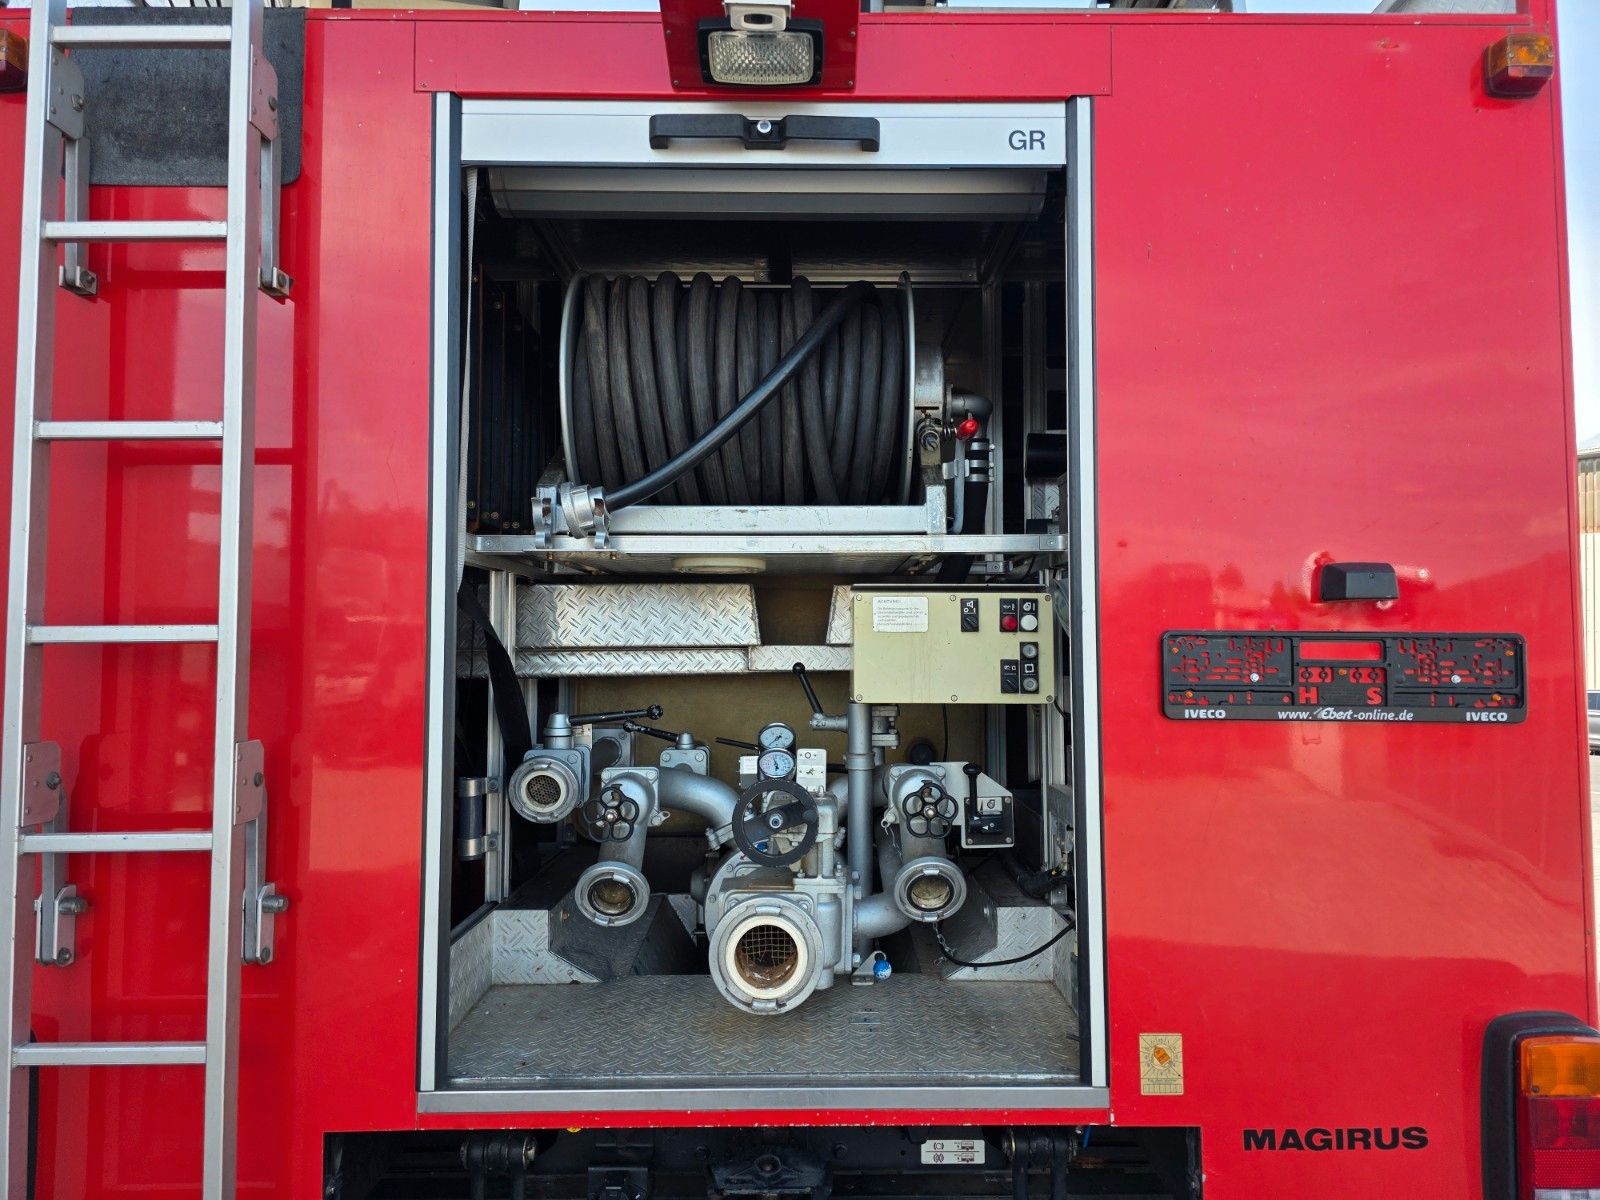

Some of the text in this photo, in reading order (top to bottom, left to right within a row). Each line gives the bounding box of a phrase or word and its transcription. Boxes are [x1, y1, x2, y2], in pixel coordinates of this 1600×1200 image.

[1008, 130, 1046, 150] GR
[1184, 708, 1227, 719] IVECO
[1465, 711, 1508, 722] IVECO
[1243, 1126, 1429, 1151] MAGIRUS
